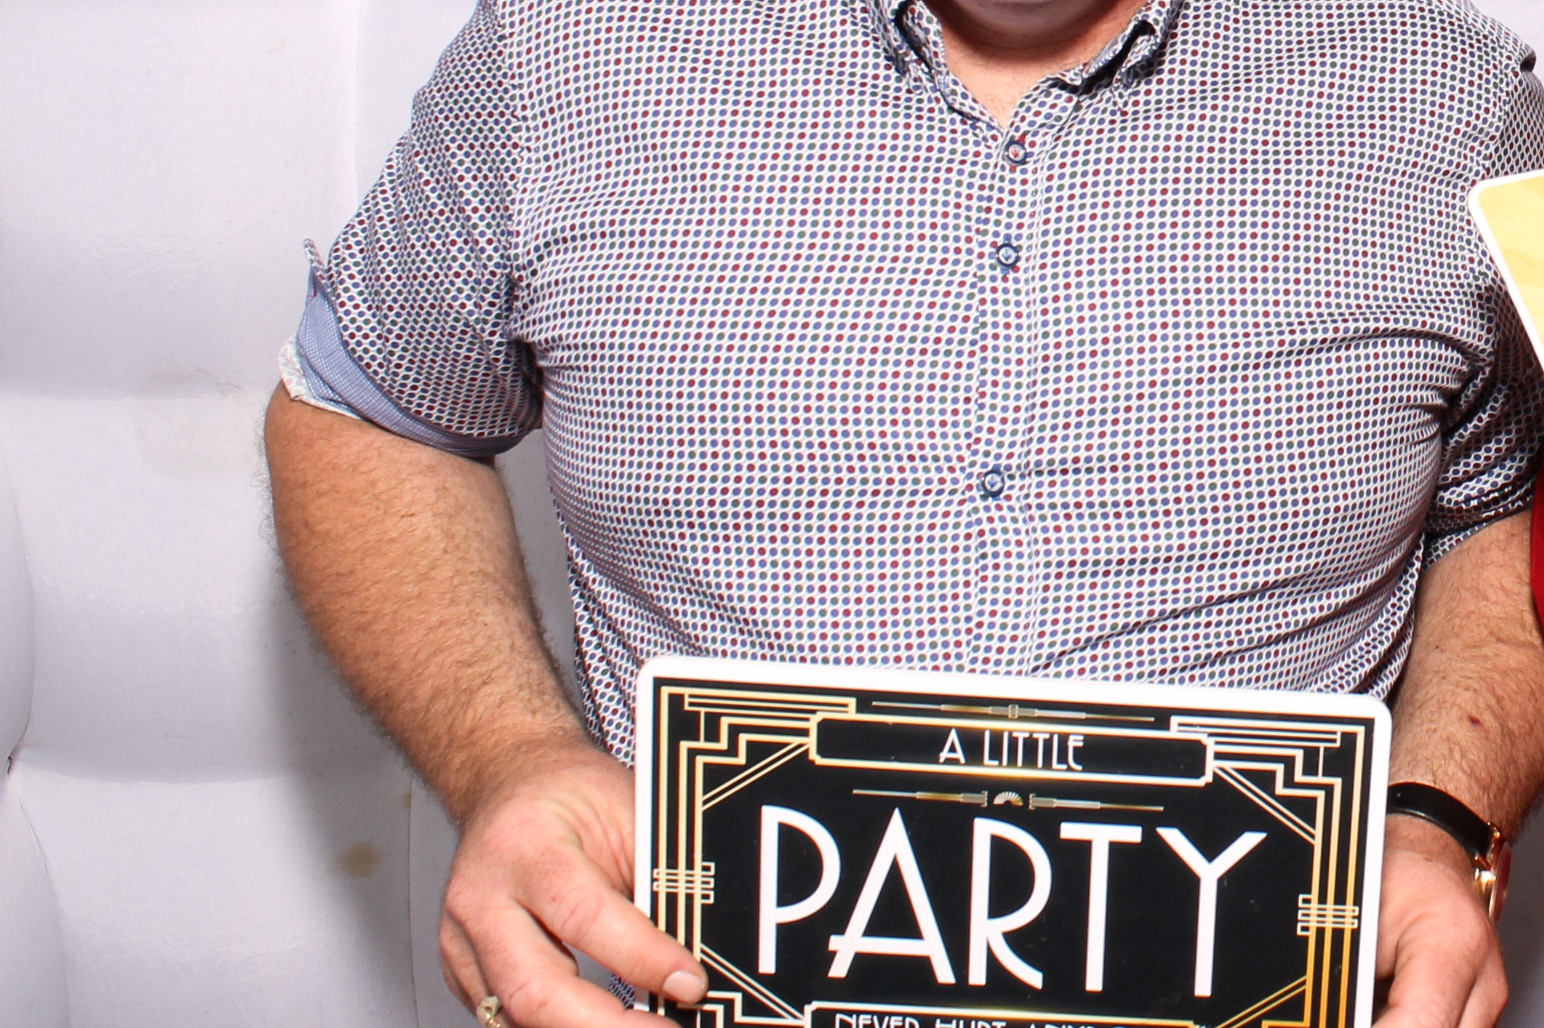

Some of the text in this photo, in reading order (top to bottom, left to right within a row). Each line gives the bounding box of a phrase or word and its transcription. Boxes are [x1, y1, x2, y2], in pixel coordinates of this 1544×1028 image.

[938, 728, 1085, 771] A LITTLE
[758, 805, 1267, 997] PARTY
